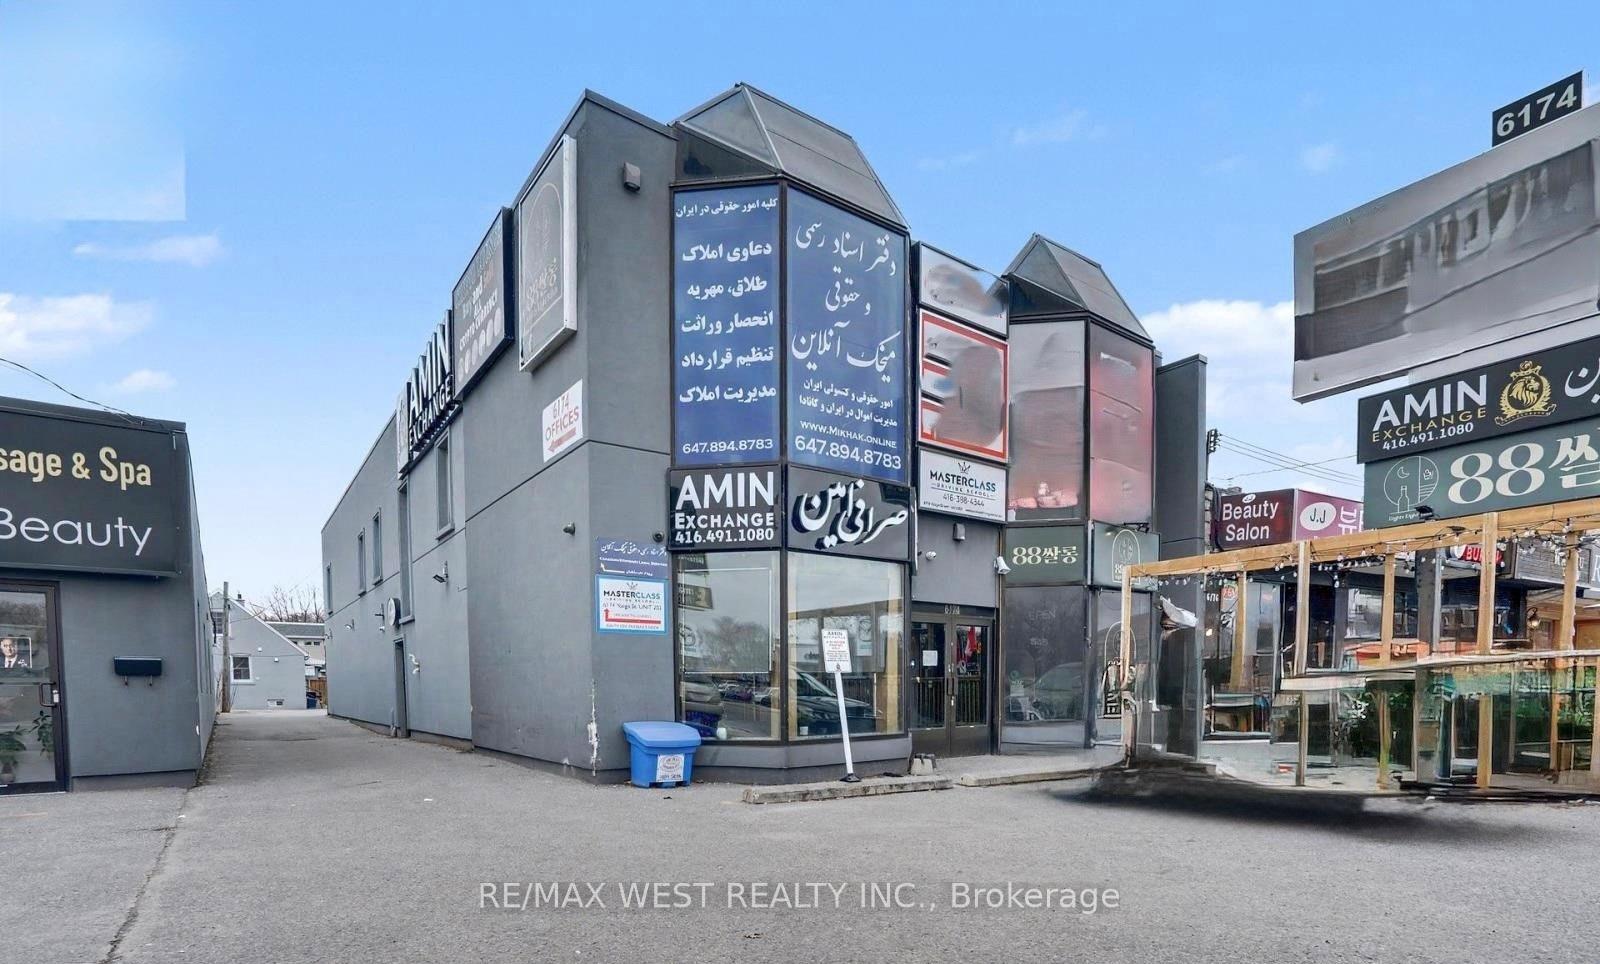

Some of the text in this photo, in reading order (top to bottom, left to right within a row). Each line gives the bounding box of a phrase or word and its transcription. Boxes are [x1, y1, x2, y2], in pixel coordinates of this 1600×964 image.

[1496, 83, 1578, 137] 6174
[675, 197, 778, 218] کلیه امور حقوقی در ایران
[681, 240, 773, 263] دعاوی املاک
[795, 221, 897, 277] دفتر اسناد رسمی
[687, 275, 768, 300] طلاق، مهریه
[825, 265, 861, 312] حقوقی
[681, 310, 774, 336] انحصار وراثت
[681, 345, 774, 371] تنظیم قرارداد
[792, 319, 902, 383] میخک آنلاین
[409, 309, 453, 428] AMIN
[679, 384, 777, 403] مدیریت املاک
[1372, 375, 1487, 432] AMIN
[545, 406, 580, 441] OFFICES
[1372, 407, 1487, 443] EXCHANGE
[1382, 421, 1475, 450] 416.491.1080
[682, 438, 774, 455] 647.894.8783
[795, 435, 902, 470] 647.894.8783
[72, 452, 91, 480] &
[99, 447, 151, 491] Spa
[929, 470, 996, 493] MASTERCLASS
[675, 471, 775, 510] AMIN
[675, 512, 775, 529] EXCHANGE
[1222, 500, 1279, 521] Beauty
[1309, 507, 1326, 523] J.J
[675, 527, 774, 544] 416.491.1080
[1225, 524, 1270, 542] Salon
[603, 590, 661, 600] MASTERCLASS
